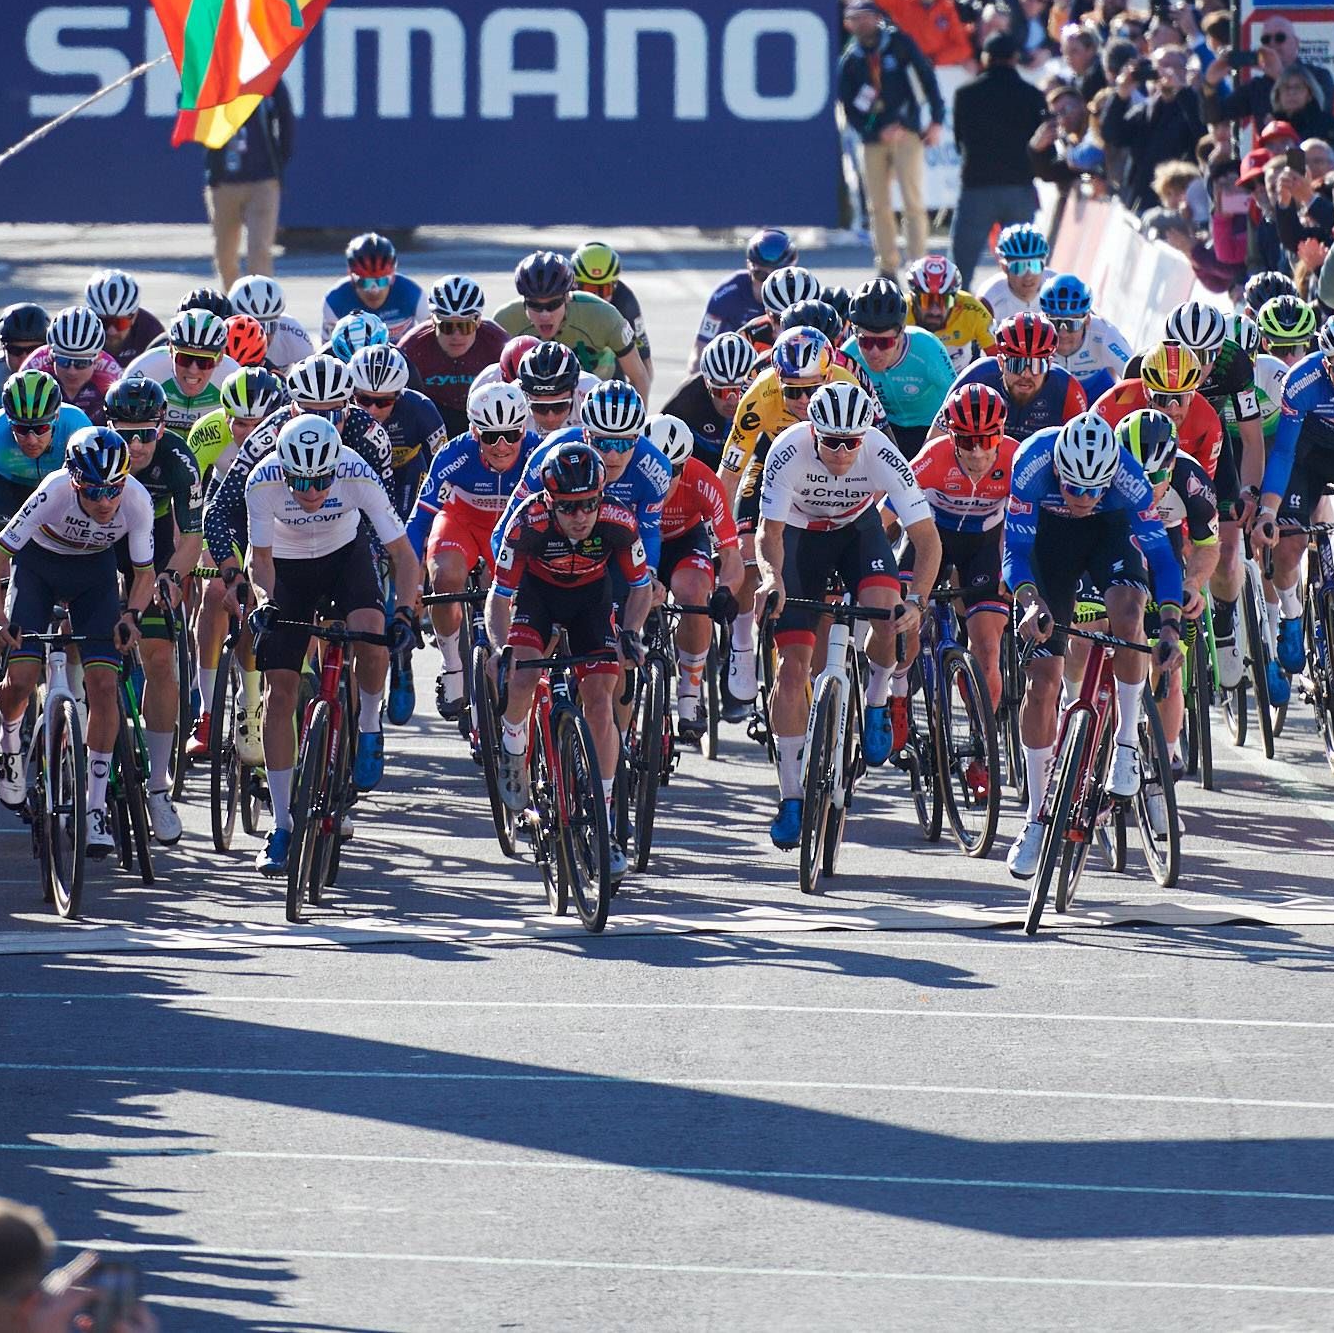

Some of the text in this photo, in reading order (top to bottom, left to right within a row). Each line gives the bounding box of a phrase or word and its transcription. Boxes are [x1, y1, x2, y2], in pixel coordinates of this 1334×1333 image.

[703, 322, 717, 332] 51
[1245, 397, 1254, 410] 2
[258, 430, 274, 448] 19
[373, 427, 385, 444] 19
[726, 450, 740, 464] 11
[768, 443, 798, 482] Crelan
[877, 447, 916, 488] FRISTADS
[1015, 449, 1052, 490] deceuninck
[809, 474, 828, 483] UCI
[697, 479, 725, 526] CANYON
[72, 518, 90, 528] UCI
[64, 526, 116, 542] INEOS
[499, 549, 508, 562] 6
[636, 547, 644, 558] 6
